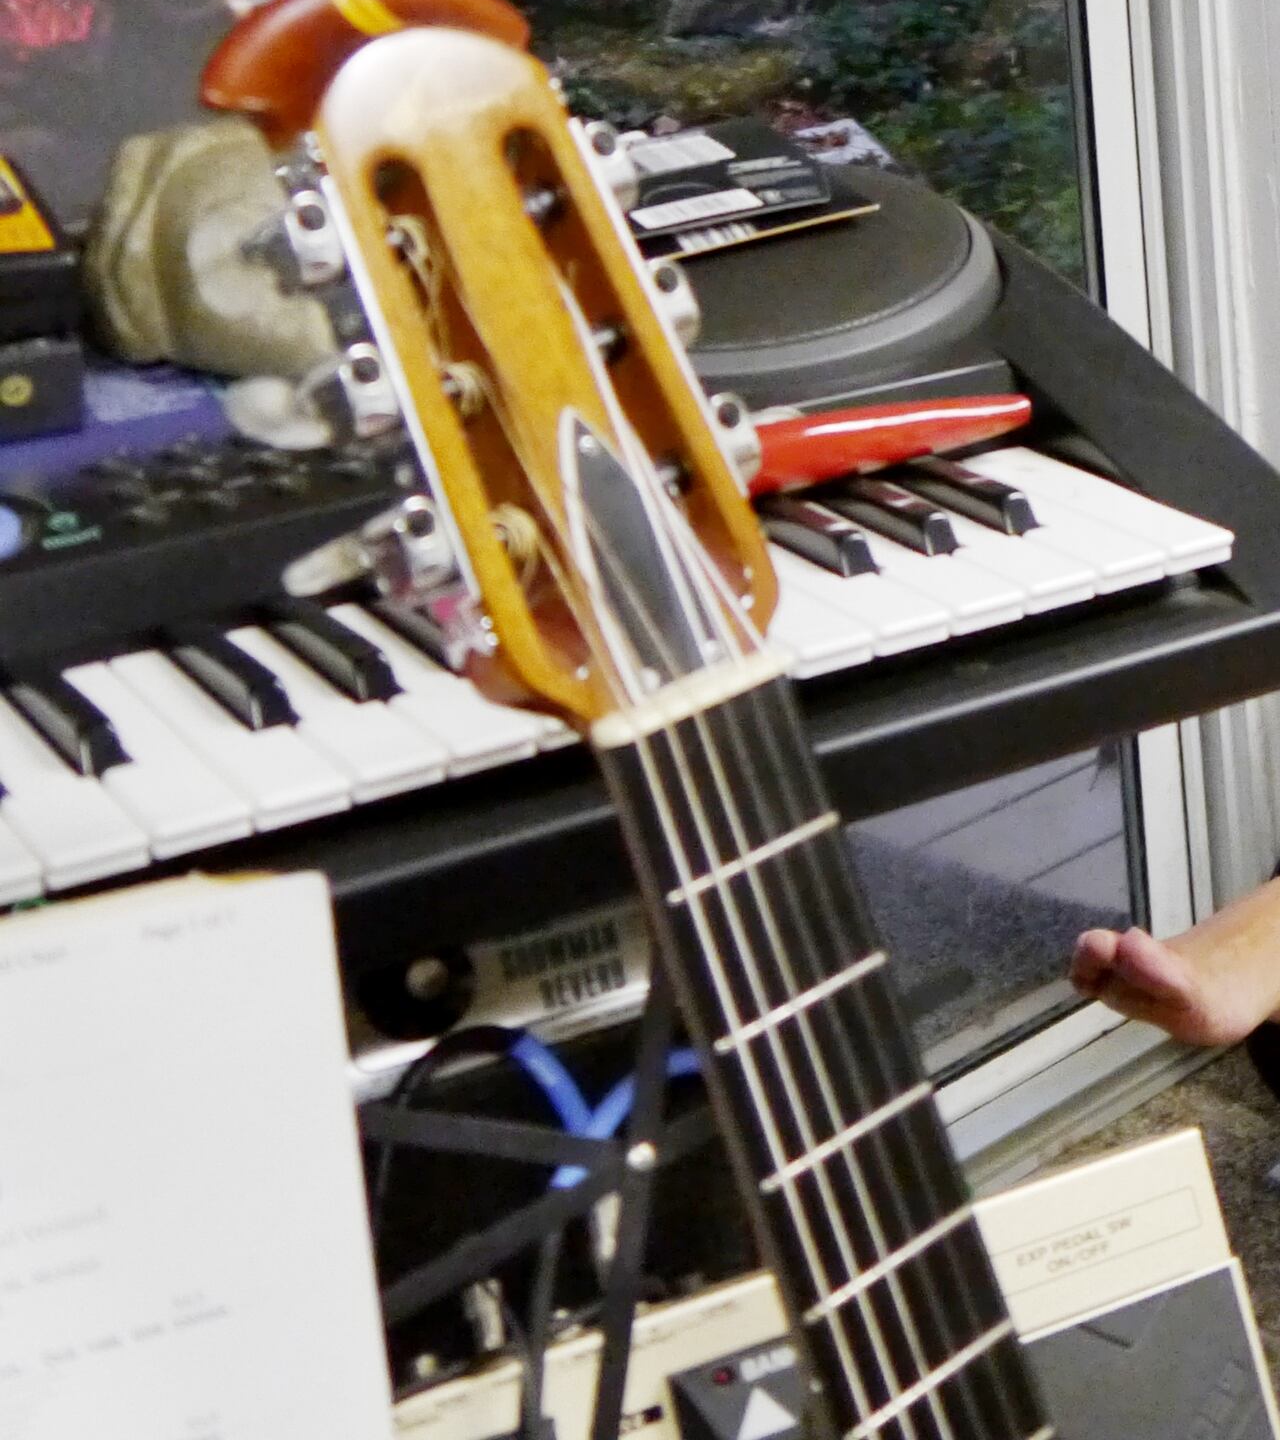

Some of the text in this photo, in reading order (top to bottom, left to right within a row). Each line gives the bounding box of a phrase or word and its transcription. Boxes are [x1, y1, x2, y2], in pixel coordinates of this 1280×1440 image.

[1051, 1227, 1104, 1252] PEDAL
[1106, 1218, 1133, 1234] SW
[1046, 1241, 1109, 1273] ON/OFF
